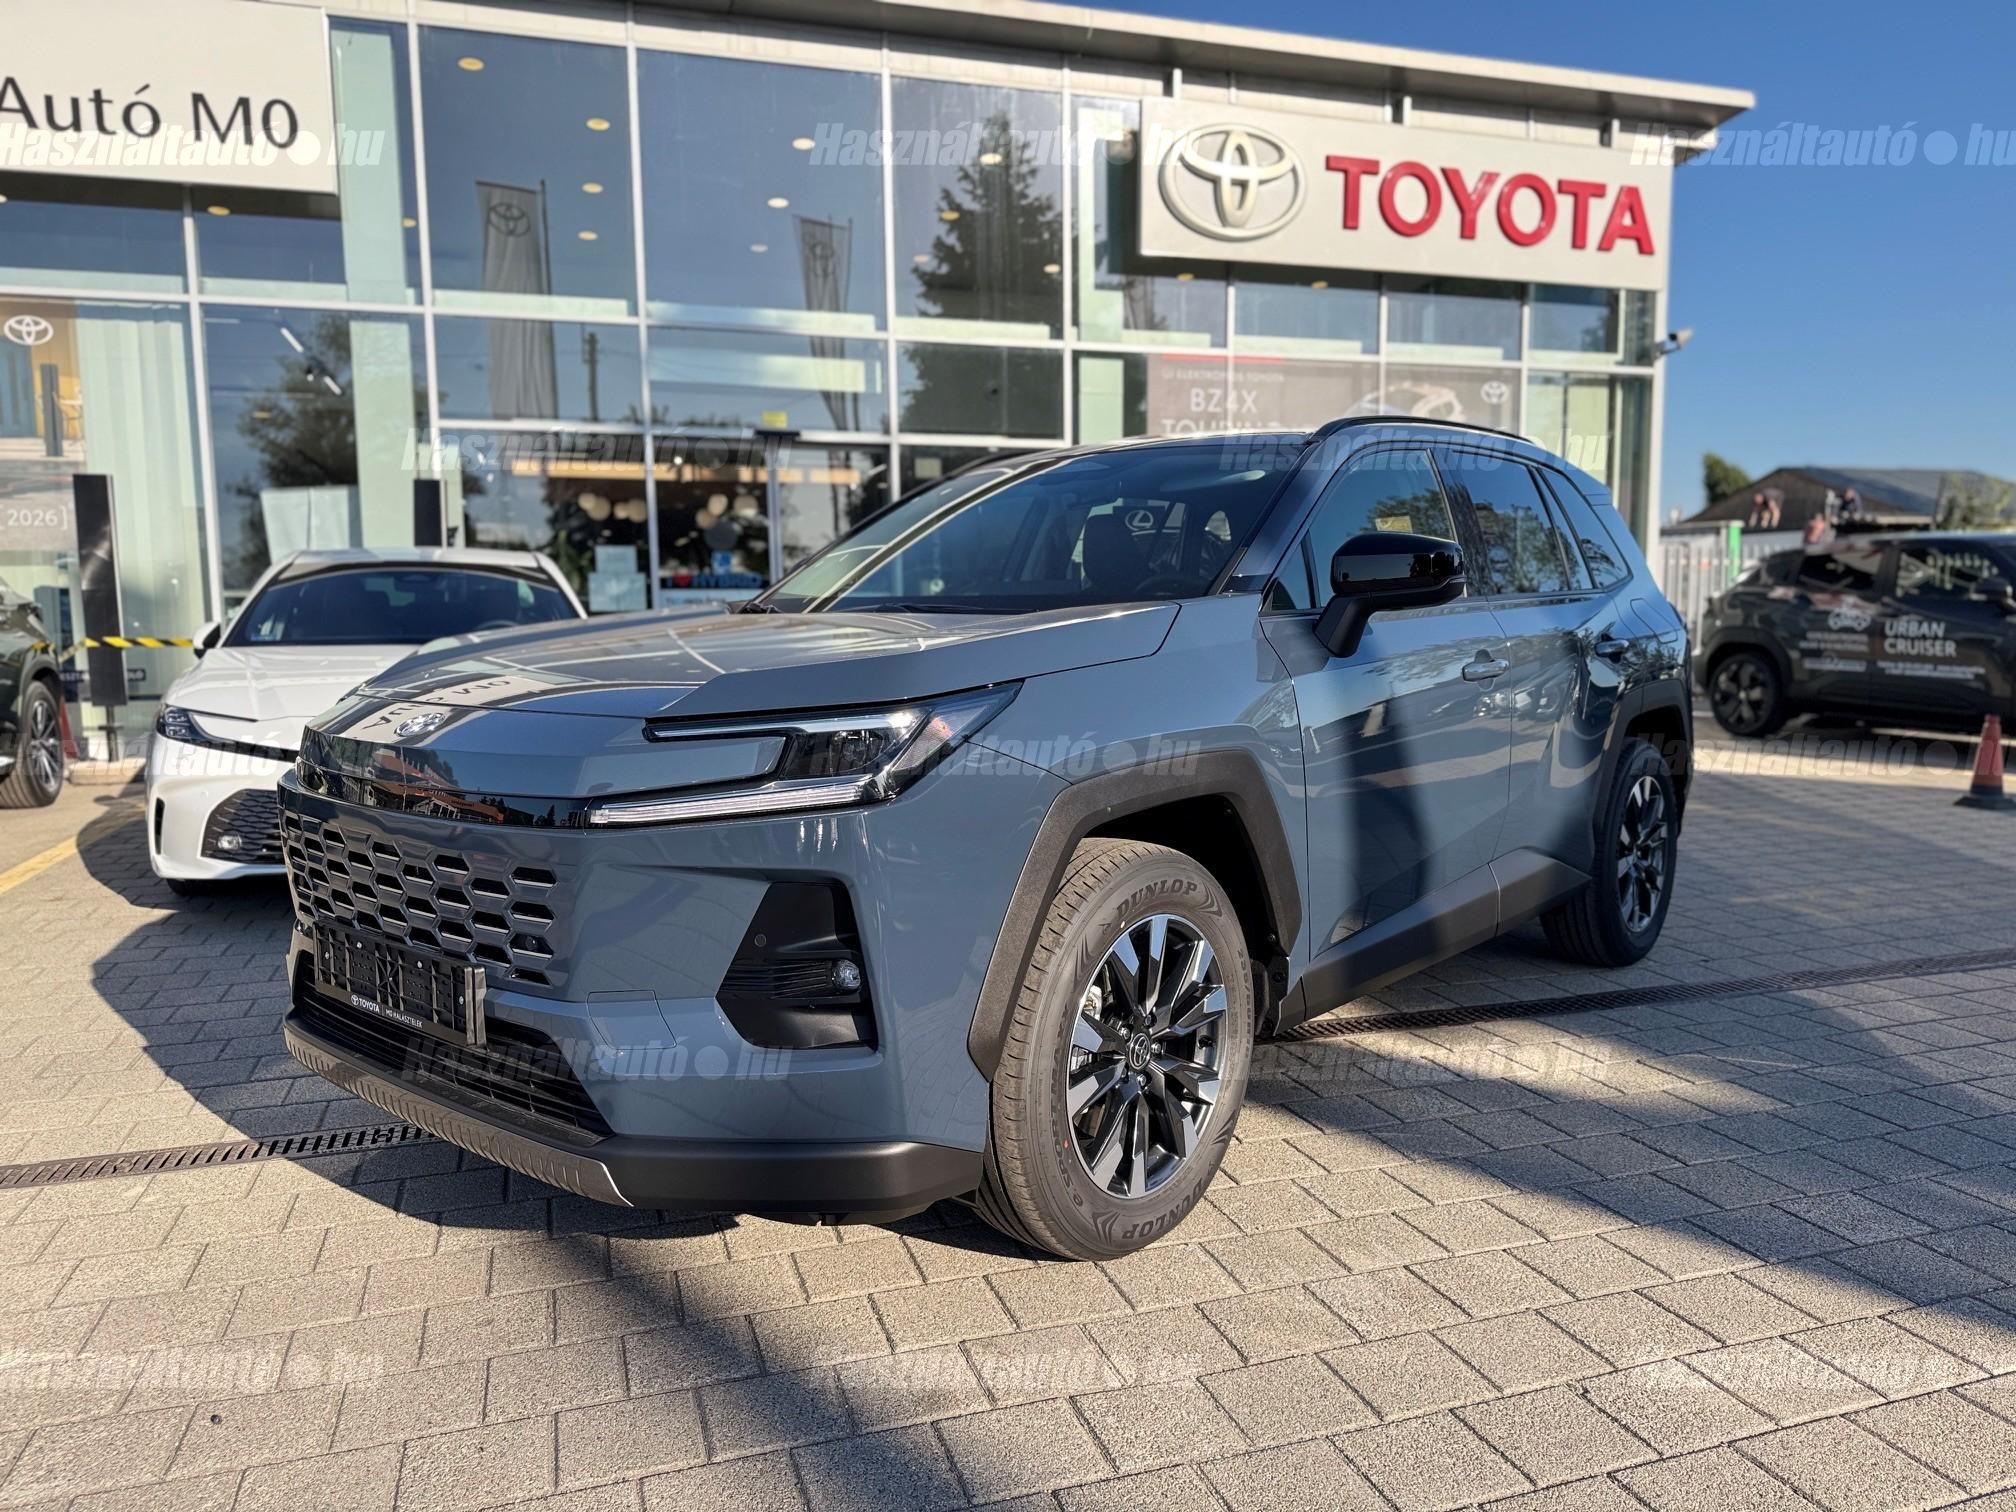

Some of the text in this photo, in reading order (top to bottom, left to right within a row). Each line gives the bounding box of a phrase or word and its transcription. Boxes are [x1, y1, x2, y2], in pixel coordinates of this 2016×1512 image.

[0, 77, 161, 138] Autó
[1326, 155, 1656, 256] TOYOTA
[1884, 619, 1946, 639] URBAN
[1884, 638, 1958, 658] CRUISER
[1116, 878, 1198, 920] DUNLOP
[360, 998, 380, 1013] TOYOTA
[1121, 1177, 1203, 1240] DUNLOP
